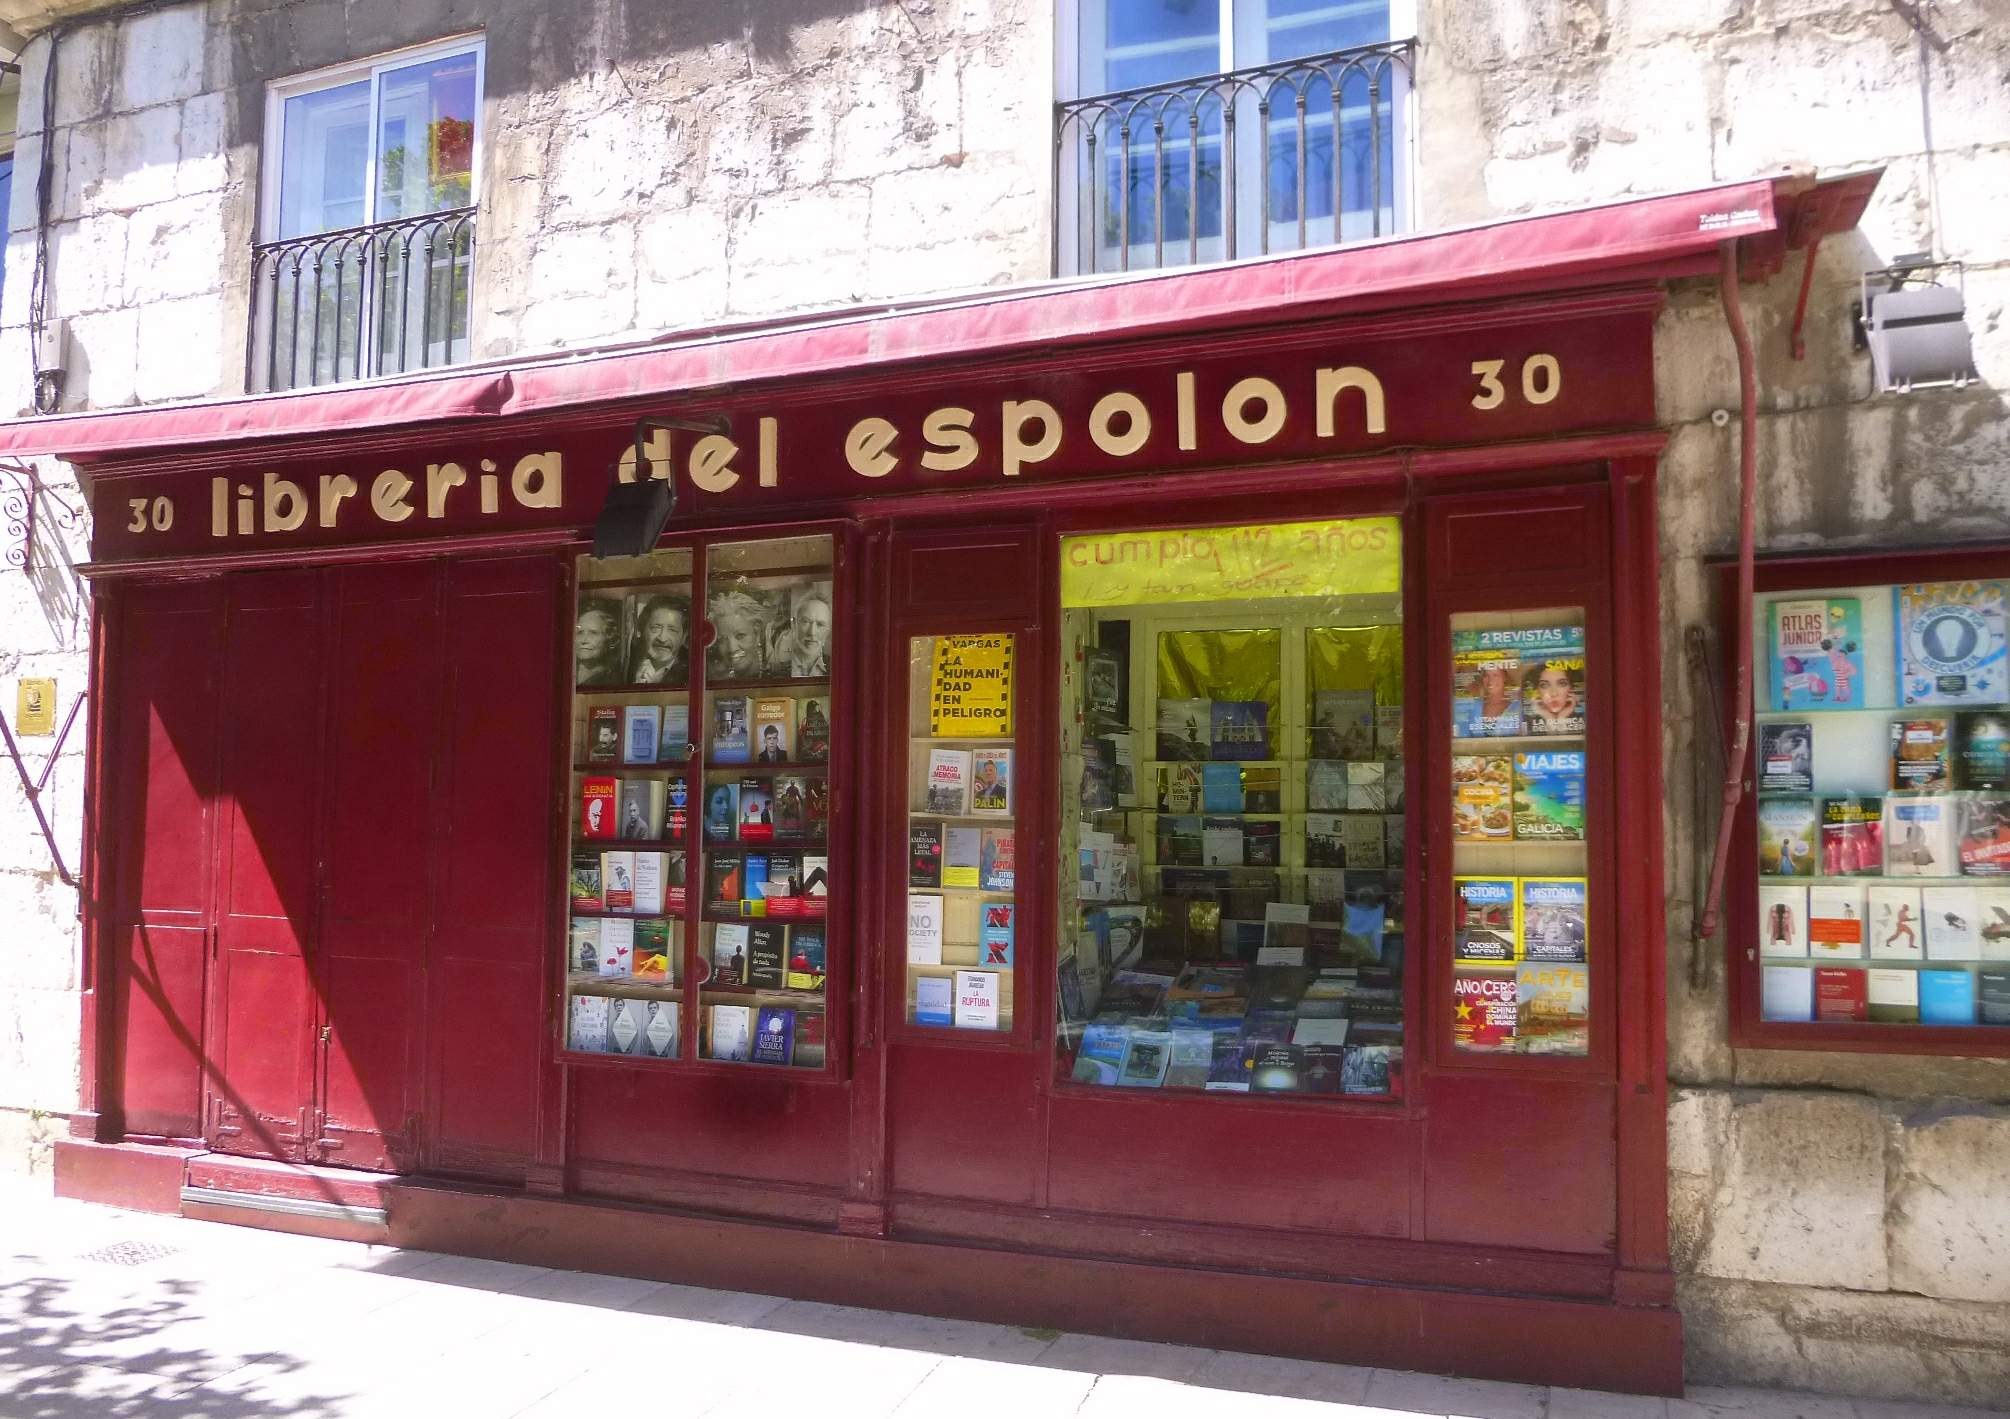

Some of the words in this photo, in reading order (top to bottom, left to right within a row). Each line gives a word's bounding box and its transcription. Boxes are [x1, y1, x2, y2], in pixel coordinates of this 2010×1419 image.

[1471, 353, 1560, 410] 30
[211, 451, 562, 537] libreria
[618, 416, 778, 493] del
[845, 366, 1387, 477] espolon
[127, 495, 174, 533] 30
[1781, 613, 1822, 631] ATLAS
[1482, 633, 1491, 644] 2
[1493, 628, 1563, 643] REVISTAS
[1782, 631, 1822, 646] JUNIOR
[943, 681, 972, 691] DAD
[942, 694, 961, 704] EN
[942, 707, 1001, 718] PELIGRO
[1519, 753, 1581, 770] VIAJES
[584, 785, 613, 794] LENIN
[1517, 823, 1564, 834] GALICIA
[1460, 886, 1508, 898] HISTORIA
[1529, 887, 1578, 899] HISTORIA
[909, 915, 932, 929] NO
